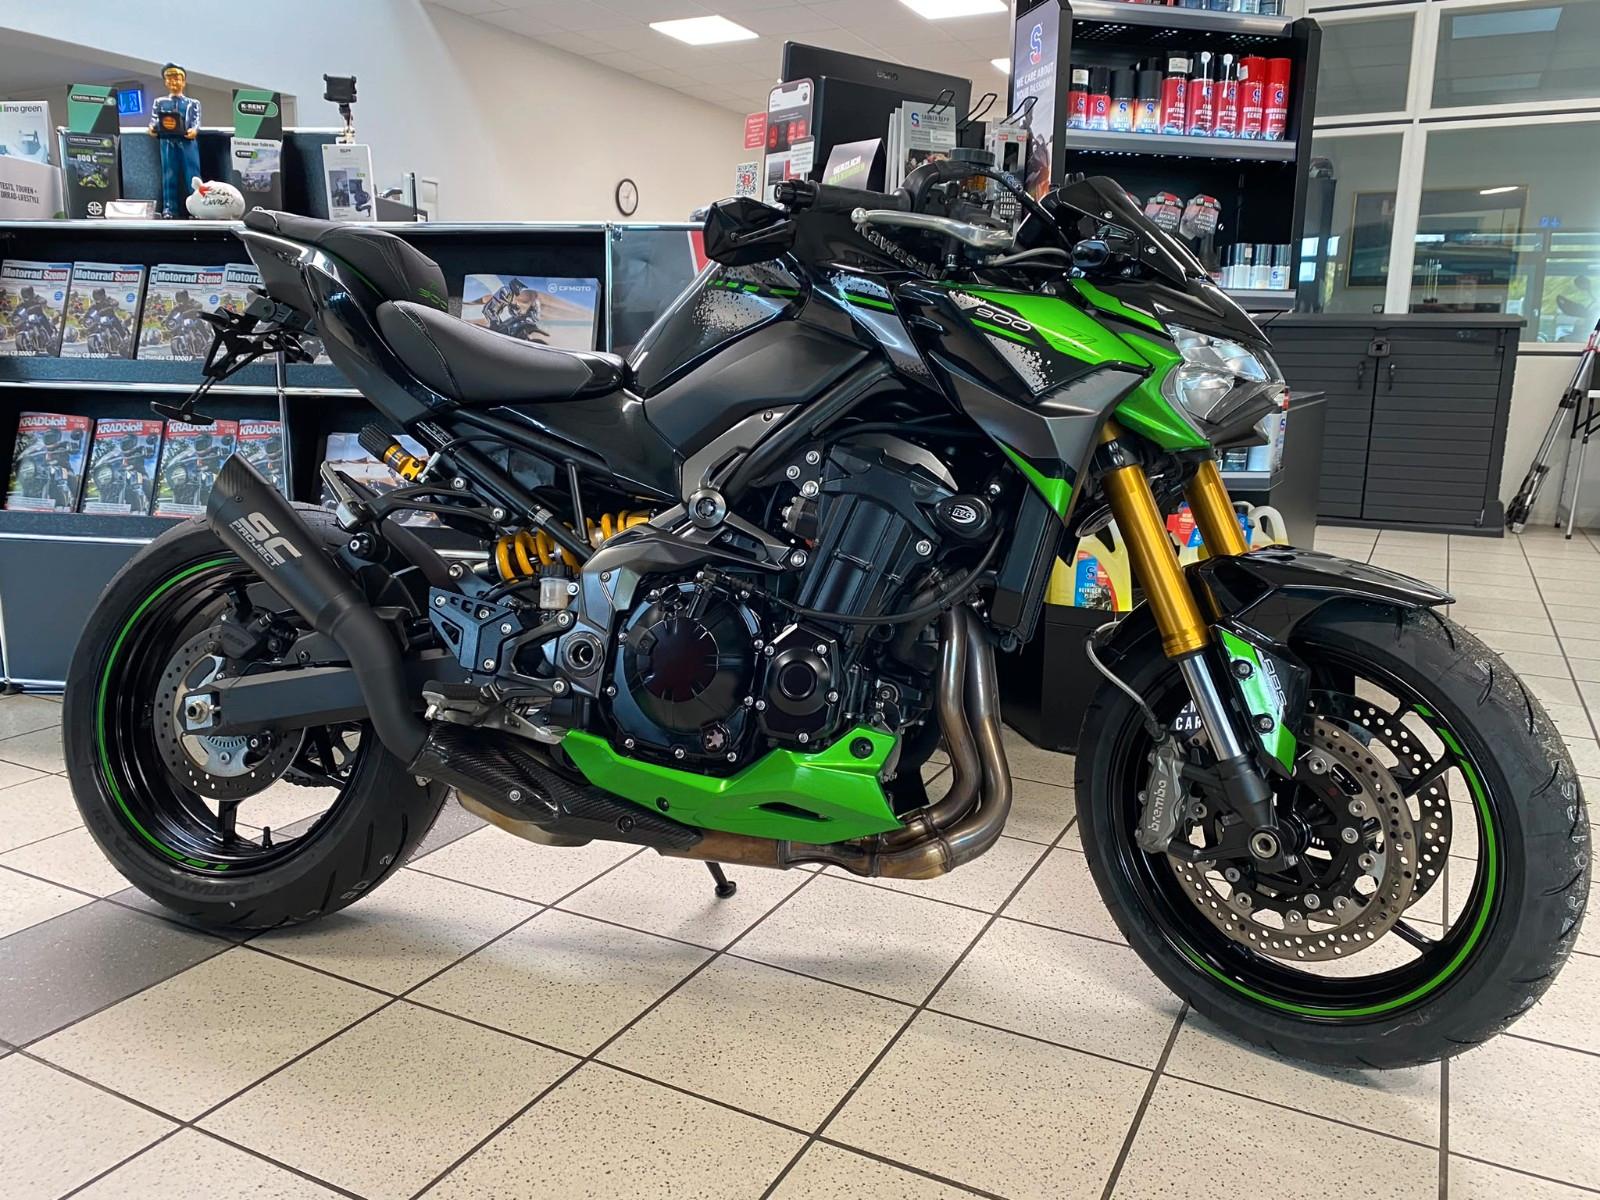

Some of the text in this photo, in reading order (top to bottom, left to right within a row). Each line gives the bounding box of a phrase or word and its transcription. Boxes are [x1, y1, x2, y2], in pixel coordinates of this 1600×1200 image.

[20, 105, 42, 114] green
[3, 267, 68, 281] Motorrad Szene
[75, 269, 138, 282] Motorrad Szene
[158, 271, 222, 284] Motorrad Szene
[227, 271, 263, 283] Motorra
[975, 307, 1032, 332] 900
[20, 415, 67, 427] KRADblatt
[97, 422, 143, 434] KRADblatt
[239, 424, 280, 435] KRADbla
[231, 519, 280, 567] PROJECT
[238, 511, 302, 565] SC
[1263, 658, 1288, 707] ABS
[1148, 779, 1168, 832] brembo
